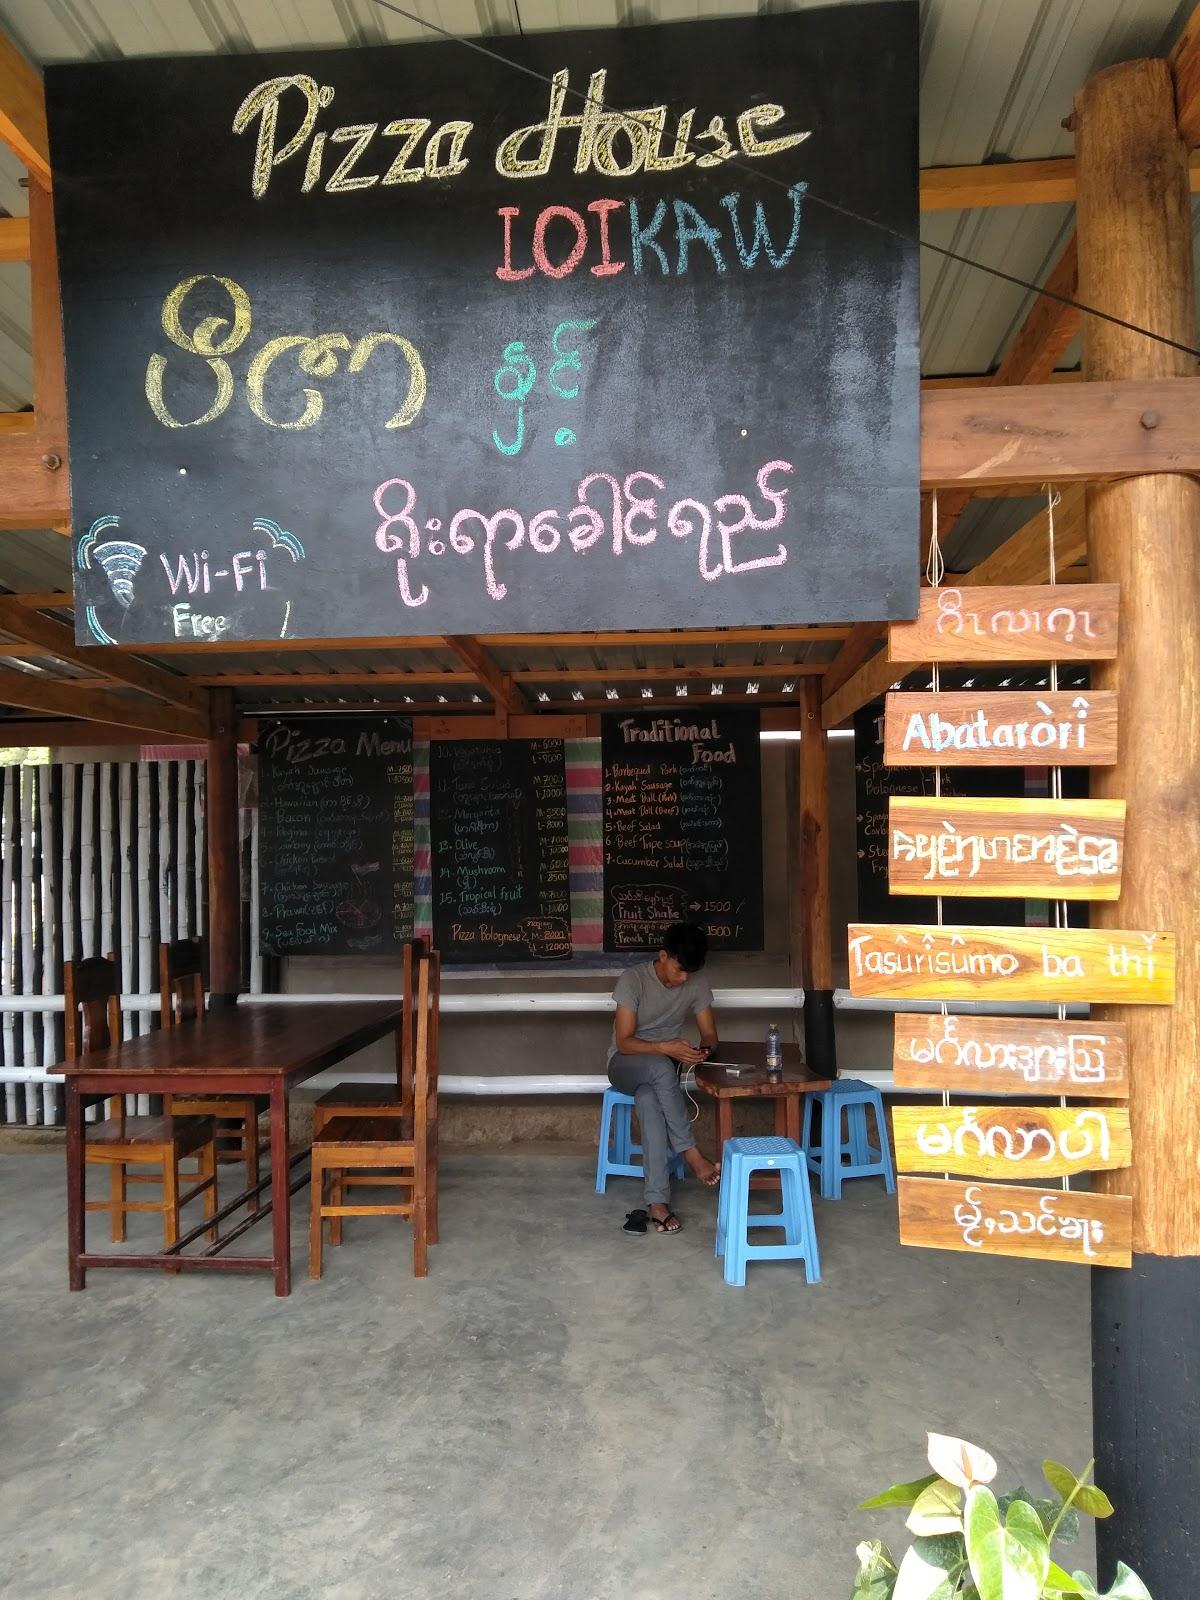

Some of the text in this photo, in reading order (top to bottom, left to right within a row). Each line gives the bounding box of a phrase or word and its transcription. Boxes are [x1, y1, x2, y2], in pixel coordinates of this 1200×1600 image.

[233, 68, 812, 198] Pizza House
[495, 182, 810, 282] LOIKAW
[160, 549, 268, 595] Wi-Fi
[172, 602, 227, 637] Free
[618, 718, 721, 744] Traditional
[264, 727, 411, 764] Pizza Menu
[690, 742, 737, 765] Food
[658, 763, 677, 776] Pork
[614, 780, 637, 796] Kayah
[640, 779, 673, 795] Sausage
[616, 794, 637, 804] Meat
[616, 819, 636, 833] Beef
[638, 821, 661, 832] Salad
[454, 838, 480, 851] Olive
[615, 834, 637, 849] Beef
[638, 833, 663, 855] Tripe
[664, 838, 686, 854] soup
[456, 864, 506, 877] Mushroom
[615, 855, 659, 868] Cucumber
[662, 855, 684, 869] Salad
[438, 883, 523, 905] 15. Tropical fruit
[618, 902, 680, 920] Fruit Shake
[703, 900, 731, 912] 1500
[318, 922, 338, 935] Mix
[451, 923, 476, 942] Pizza
[478, 922, 520, 948] Bolognese
[618, 931, 666, 944] French Frie
[706, 924, 731, 937] 1500
[1042, 944, 1084, 978] ba
